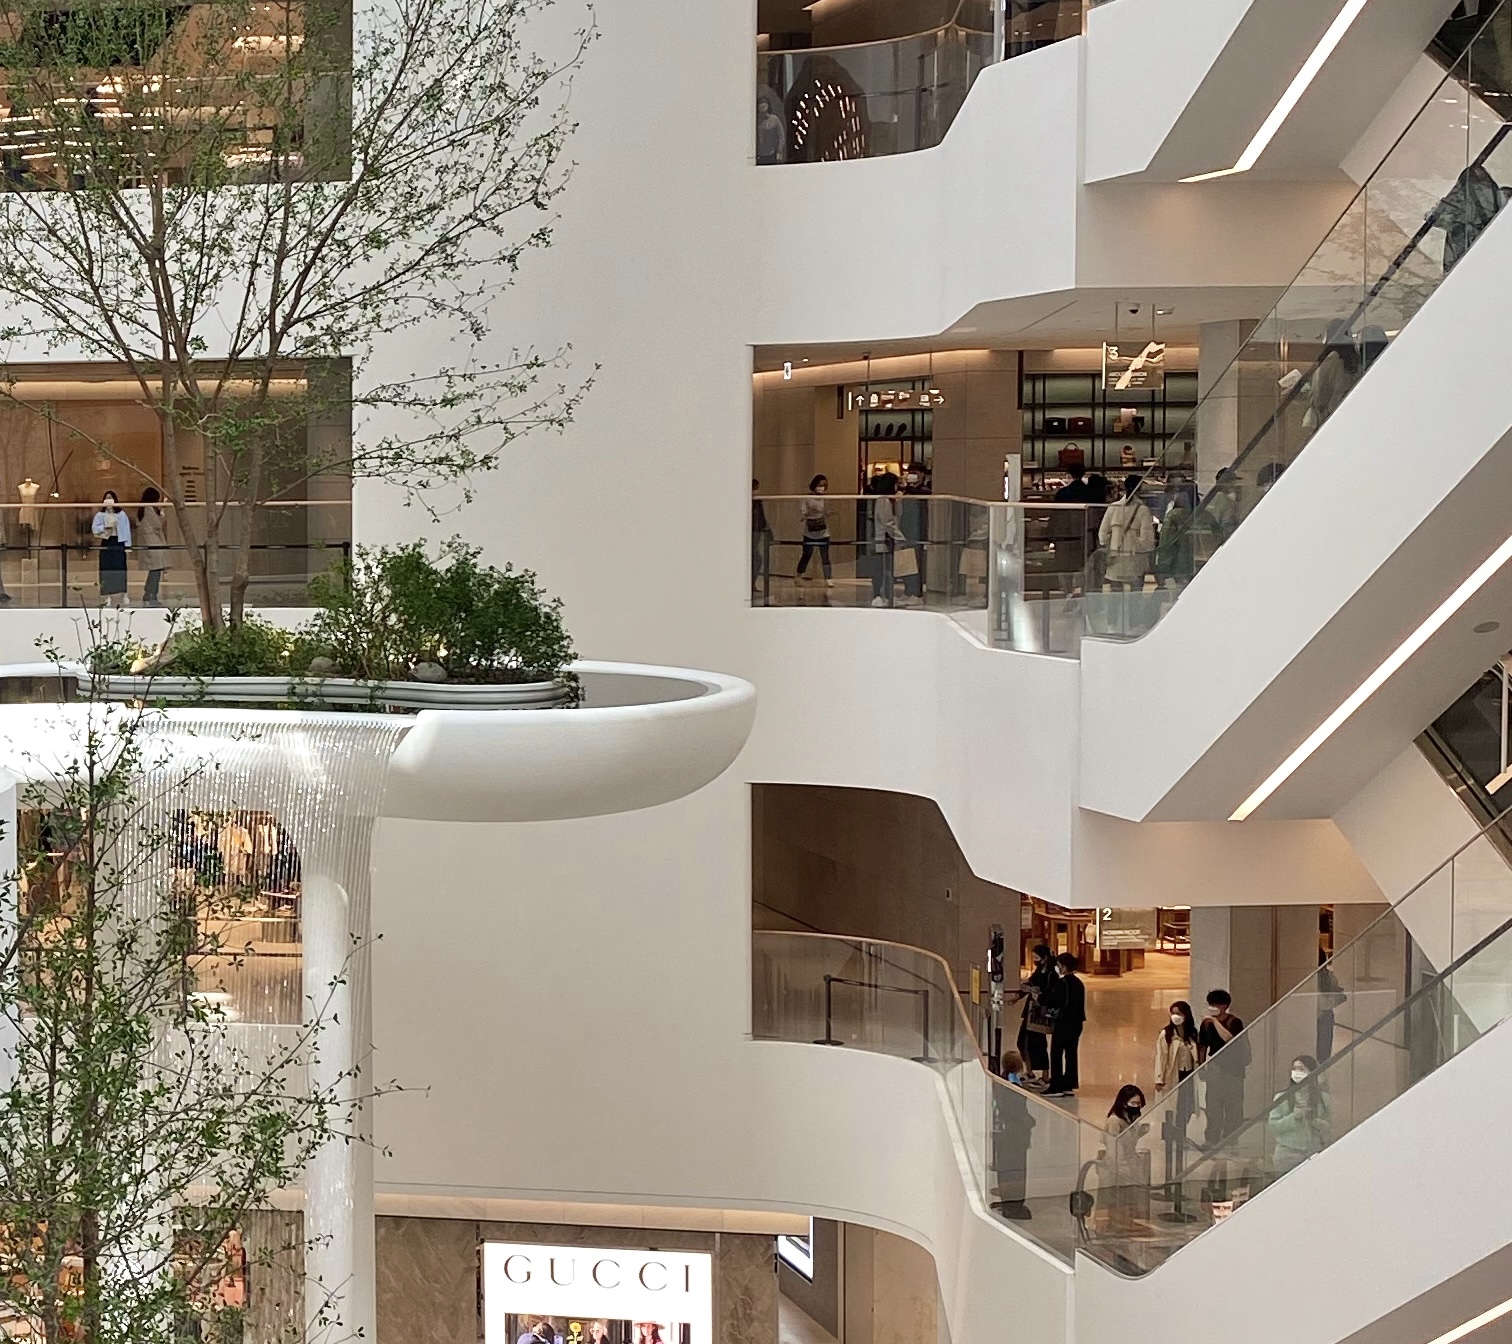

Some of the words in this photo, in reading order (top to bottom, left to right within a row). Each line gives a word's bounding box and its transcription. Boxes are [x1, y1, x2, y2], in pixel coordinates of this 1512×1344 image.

[1109, 346, 1118, 359] 3
[1103, 908, 1112, 920] 2
[504, 1254, 690, 1292] GUCCI
